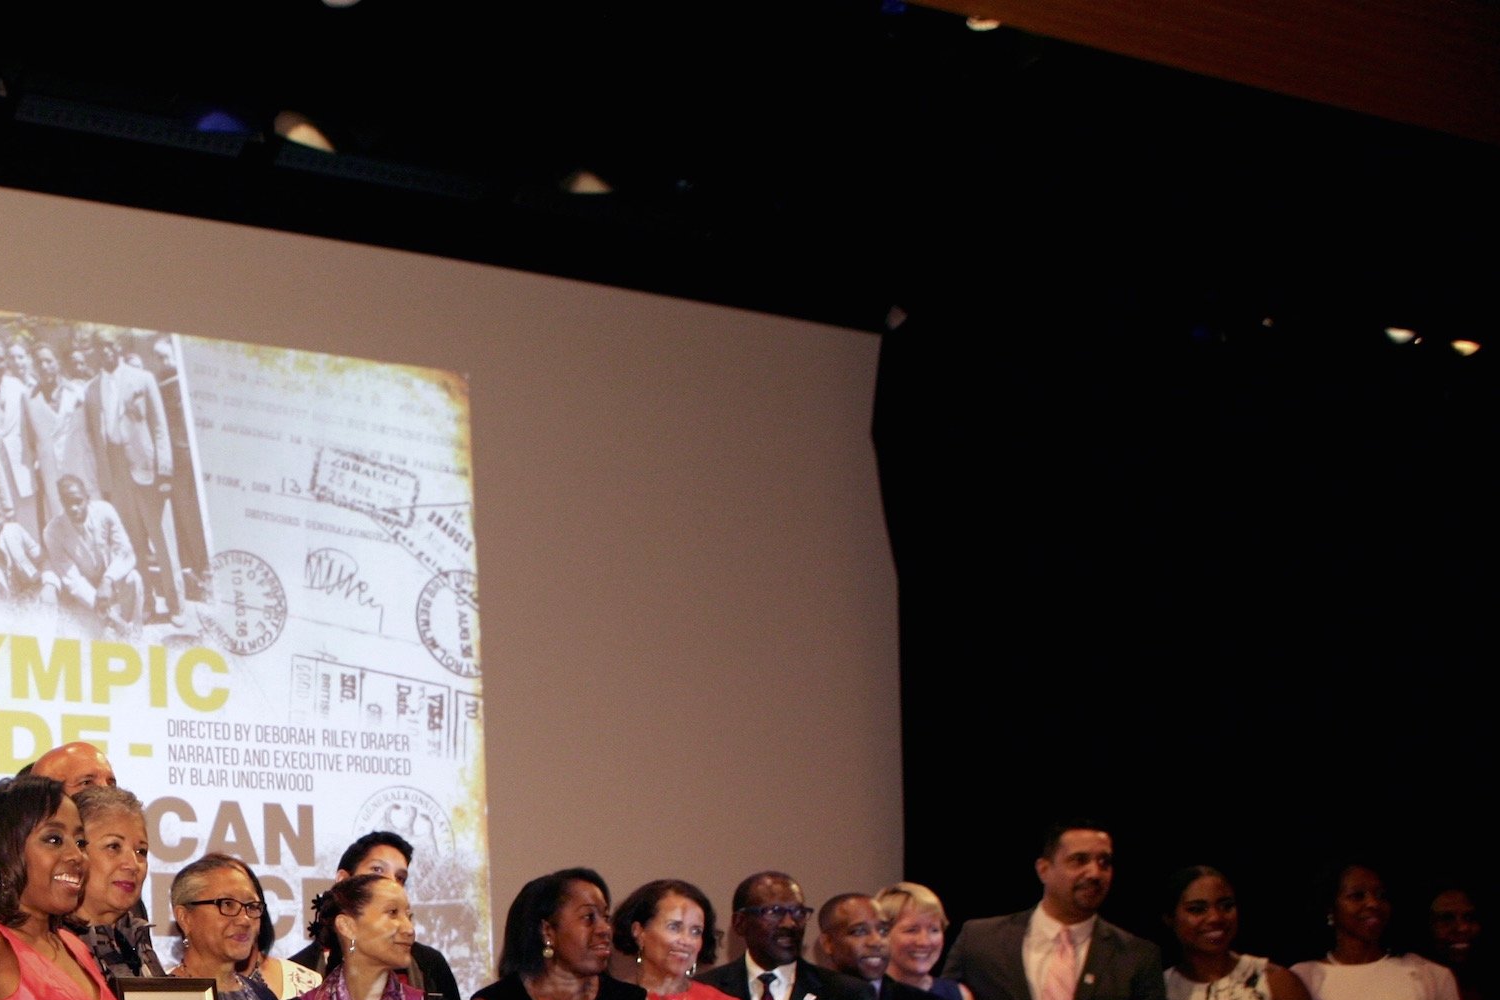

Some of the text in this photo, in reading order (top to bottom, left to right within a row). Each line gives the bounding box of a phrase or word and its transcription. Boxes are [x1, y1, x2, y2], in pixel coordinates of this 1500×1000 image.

[427, 692, 443, 732] VISA
[167, 719, 231, 741] DIRECTED
[234, 723, 252, 742] BY
[255, 724, 315, 746] DEBORAH
[322, 729, 357, 749] RILEY
[360, 731, 410, 752] DRAPER
[167, 744, 412, 777] NARRATED AND EXECUTIVE PRODUCED
[169, 766, 314, 792] BY BLAIR UNDERWOOD
